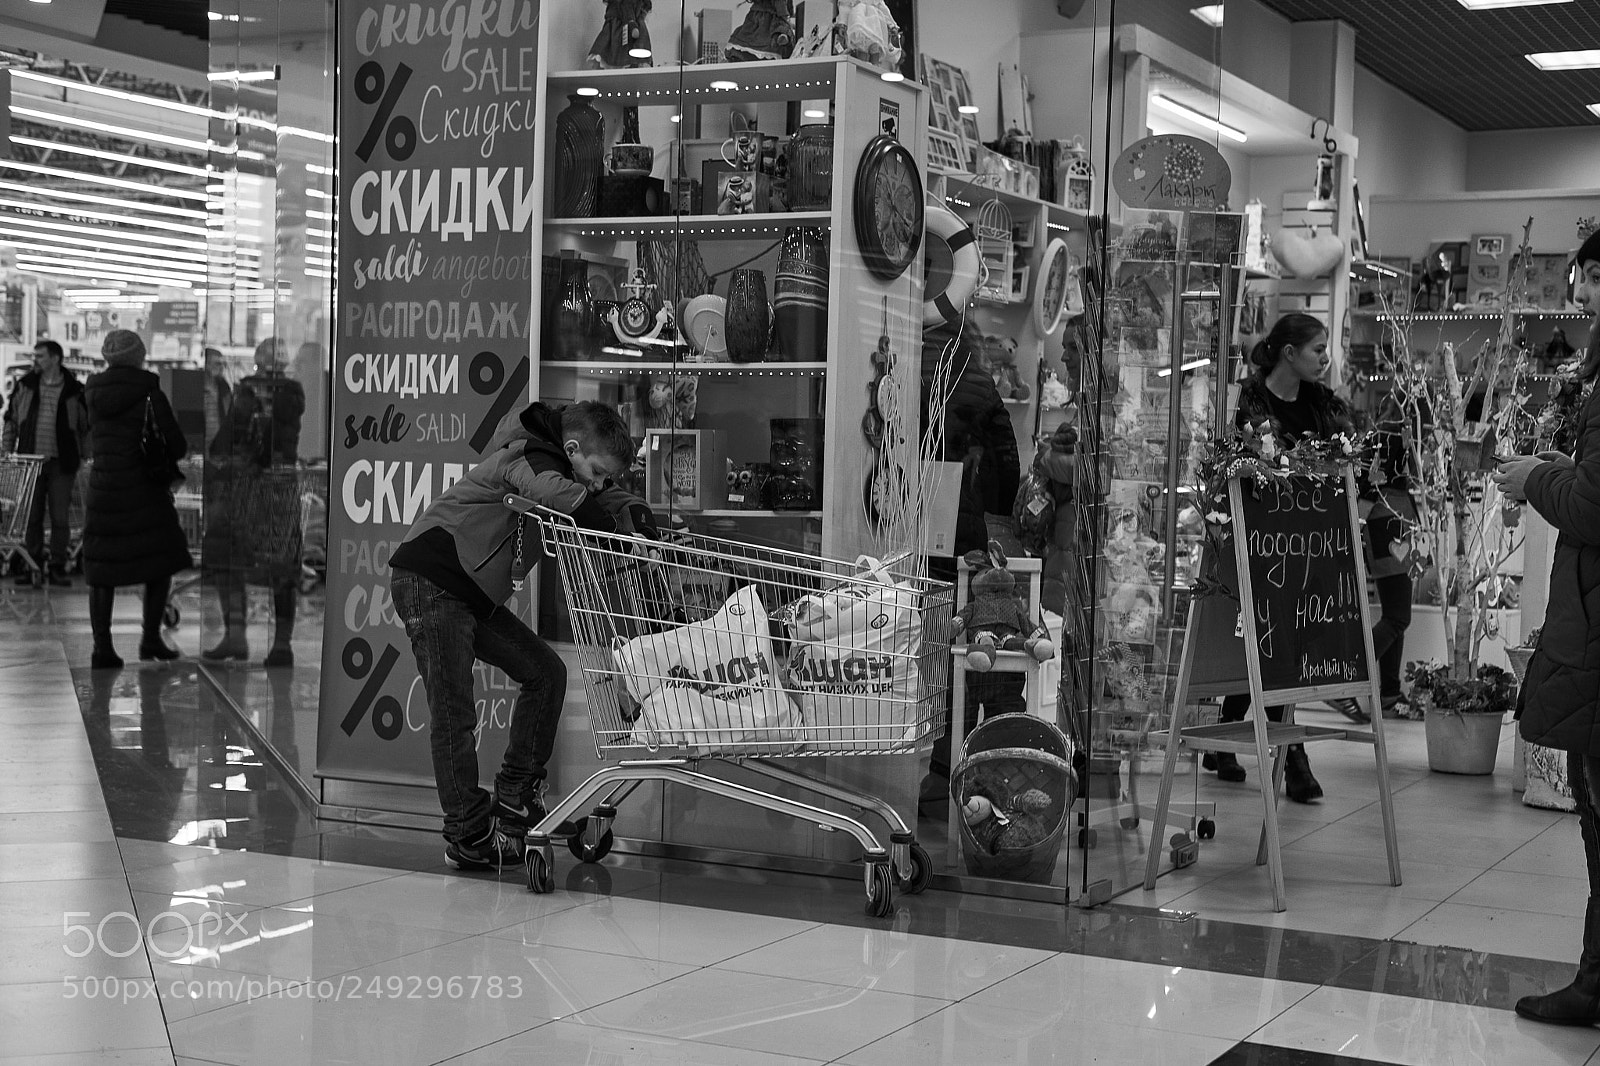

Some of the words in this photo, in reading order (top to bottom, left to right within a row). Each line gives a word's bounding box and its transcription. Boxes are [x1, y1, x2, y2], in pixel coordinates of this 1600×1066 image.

[462, 48, 533, 95] SALE
[350, 167, 534, 241] СКИДКИ
[354, 238, 429, 290] saldi
[344, 353, 459, 399] СКИДКИ
[344, 403, 411, 449] sale
[416, 413, 466, 443] SALDI
[1249, 527, 1350, 590] подарки
[1257, 599, 1277, 659] у
[818, 683, 868, 696] НИЗКИХ
[871, 682, 894, 696] ЦЕН
